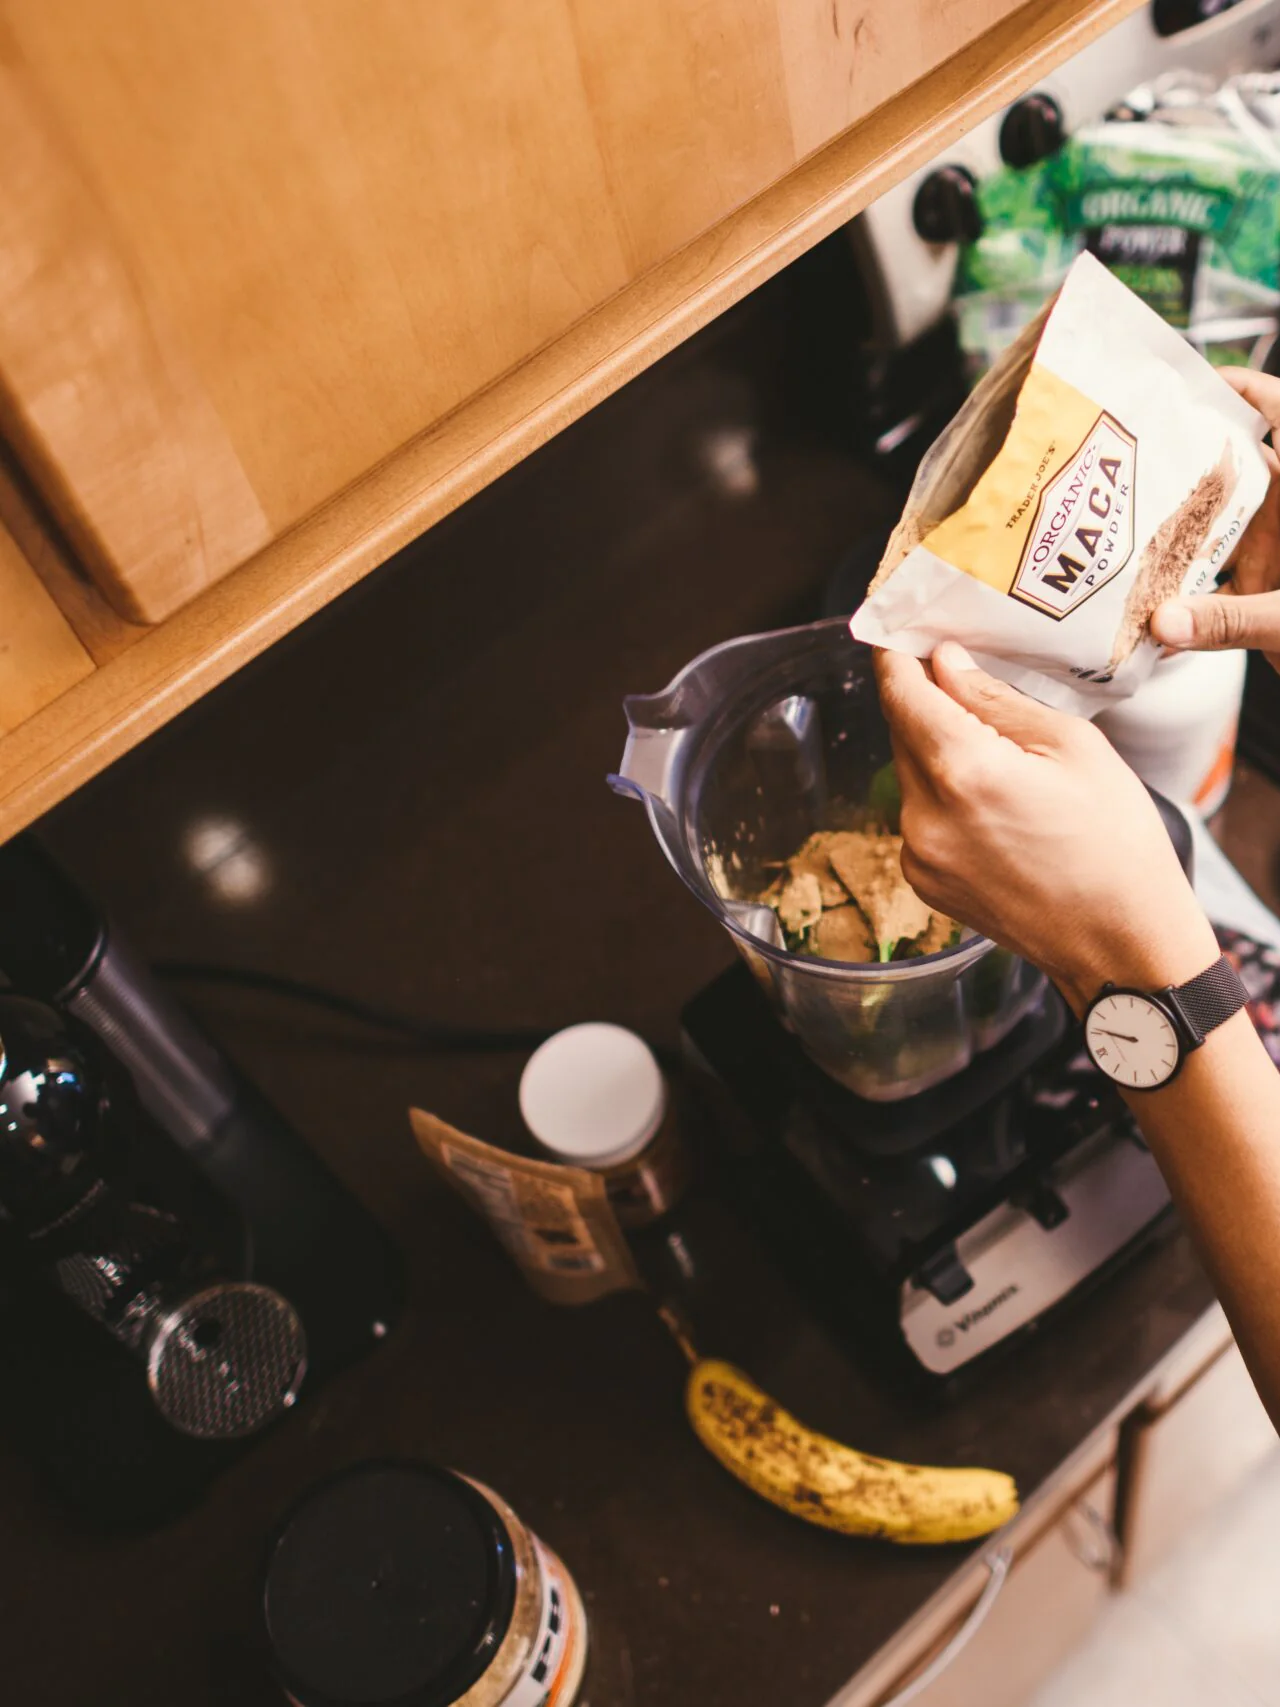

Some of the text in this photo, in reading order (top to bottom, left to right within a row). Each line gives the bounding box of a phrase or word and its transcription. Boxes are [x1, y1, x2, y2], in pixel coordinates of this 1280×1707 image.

[1082, 187, 1221, 227] ORGANIC
[1005, 444, 1056, 529] TRADER JOE'S
[1032, 447, 1096, 563] ORGANIC
[1041, 457, 1122, 594] MACA
[1085, 483, 1129, 586] POWDER
[1210, 520, 1241, 565] (227g)
